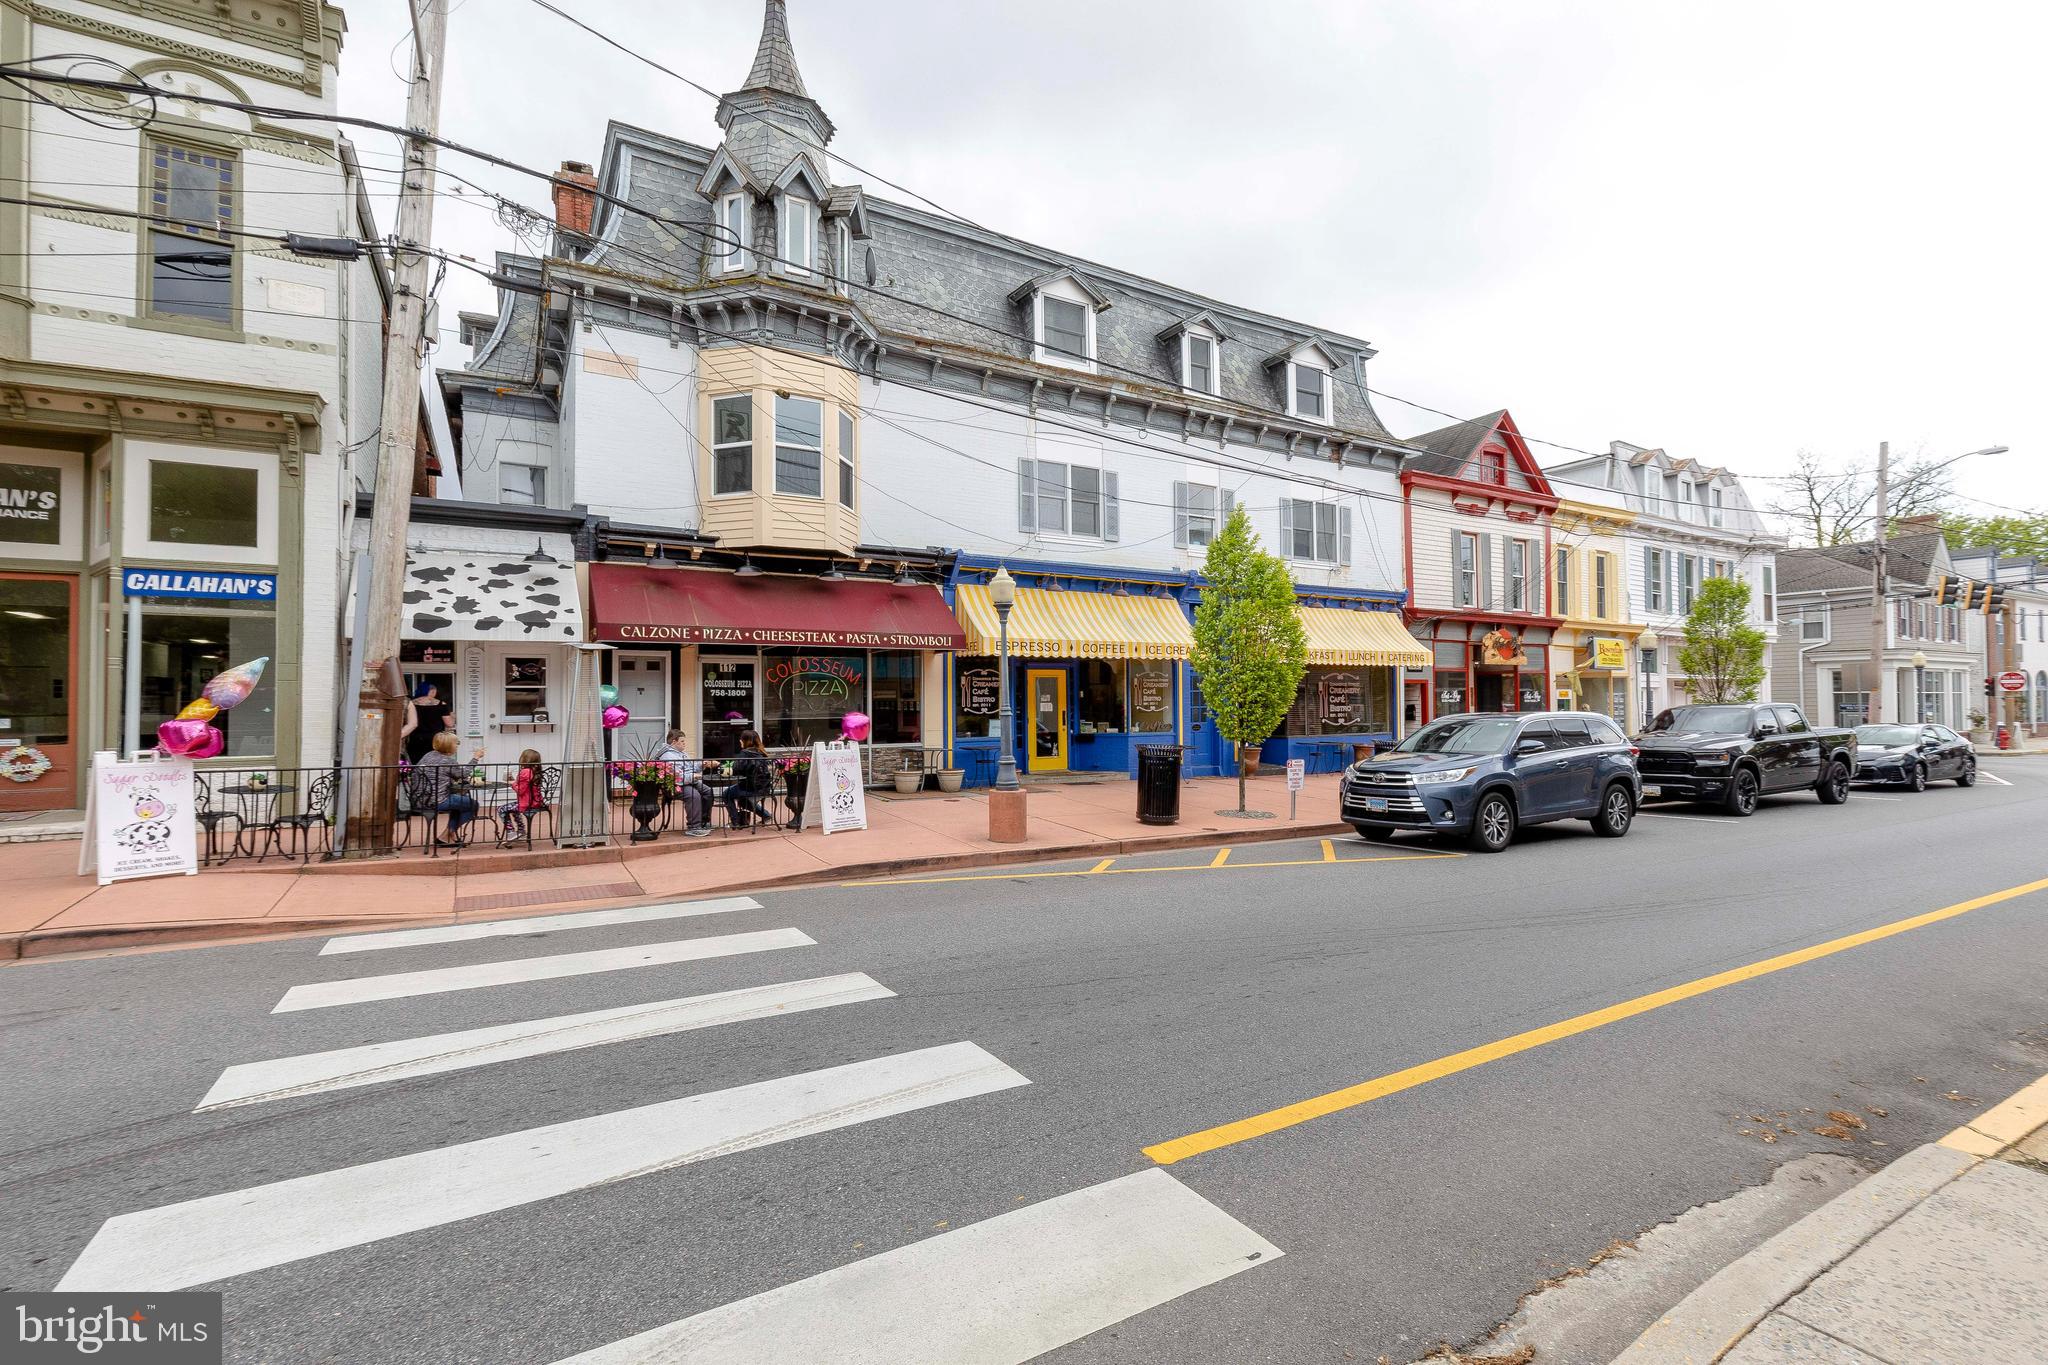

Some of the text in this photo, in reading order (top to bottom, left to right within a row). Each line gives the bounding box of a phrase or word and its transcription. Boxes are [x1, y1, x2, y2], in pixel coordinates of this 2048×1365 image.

[127, 573, 273, 595] CALLAHAN'S
[621, 626, 952, 646] CALZONE PIZZA CHEESESTEAK PASTA STROMBOLI
[1082, 643, 1125, 654] COFFEE
[1145, 645, 1162, 655] ICE
[1165, 645, 1195, 656] CREA
[1309, 651, 1425, 662] KFAST LUNCH CATERING
[721, 664, 736, 672] 112
[766, 656, 862, 685] COLOSSEUM
[704, 680, 753, 688] COLOSSEUM PIZZA
[792, 679, 843, 696] PIZZA
[710, 689, 746, 697] 758-1800
